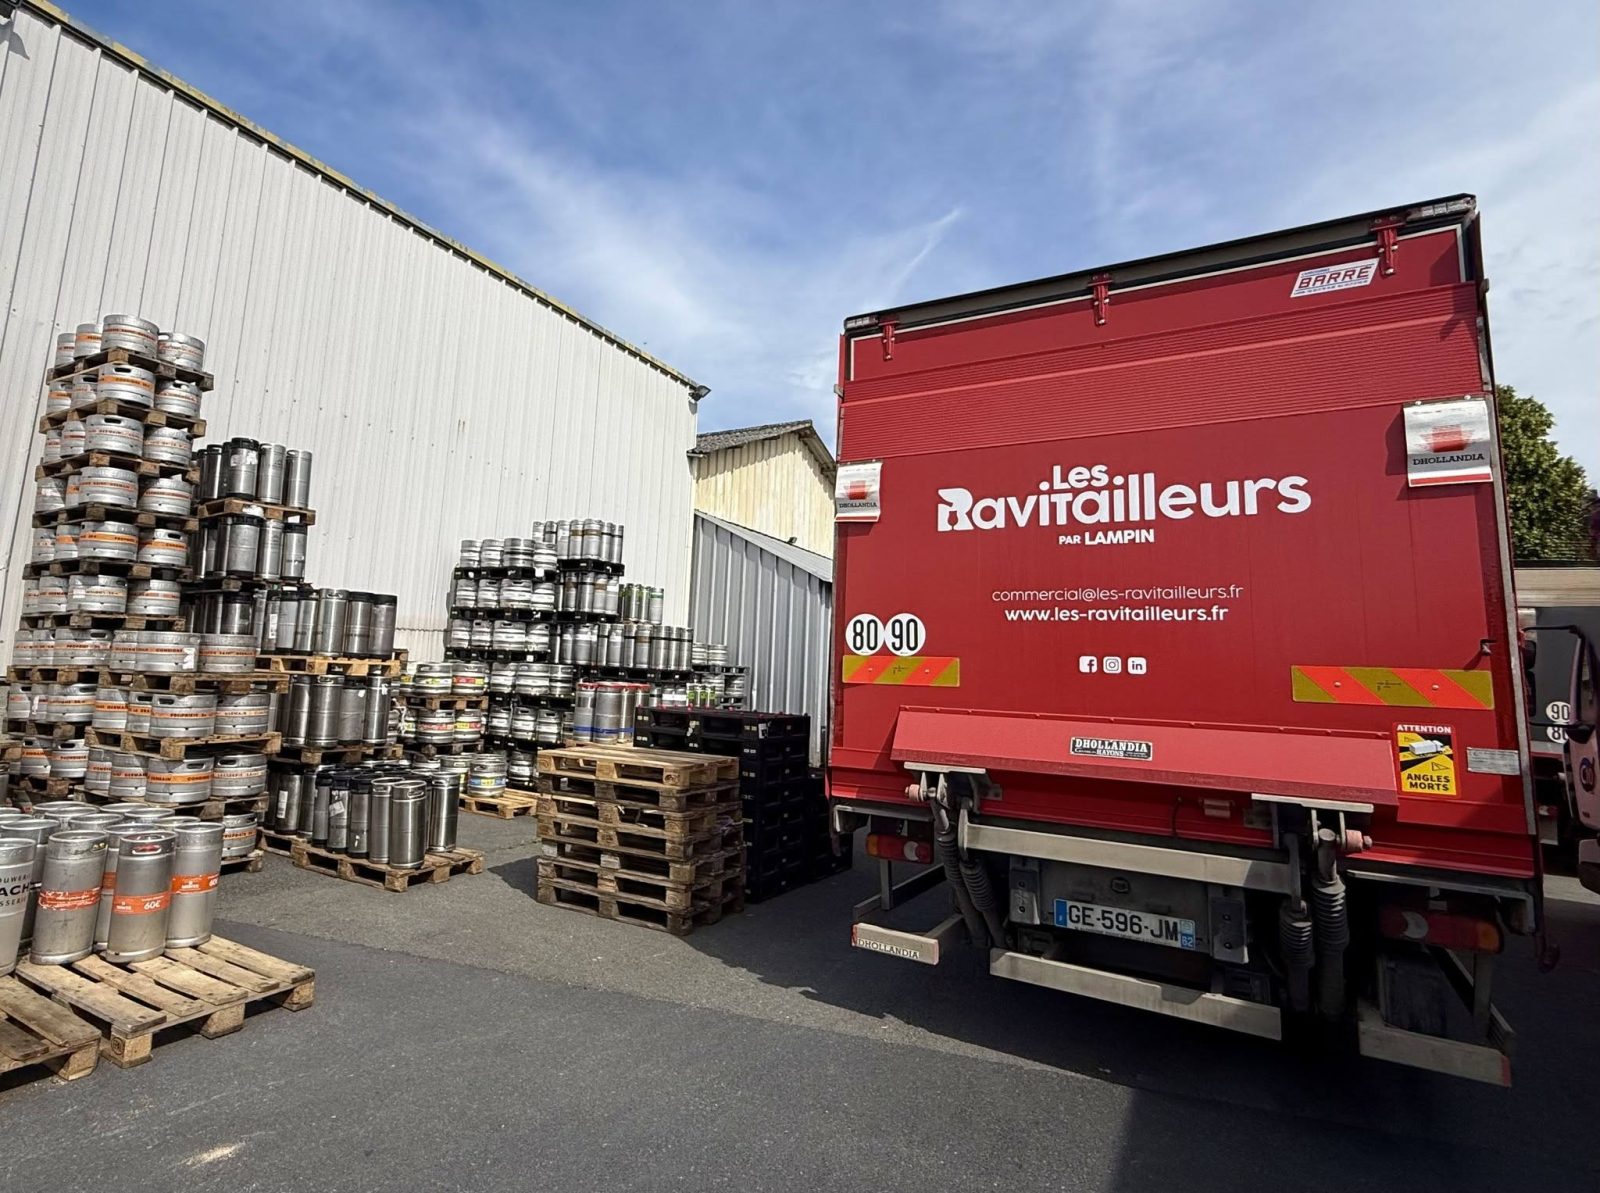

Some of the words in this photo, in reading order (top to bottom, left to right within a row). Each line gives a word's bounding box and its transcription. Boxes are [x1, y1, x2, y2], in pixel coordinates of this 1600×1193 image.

[1413, 453, 1485, 465] DHOLLANDIA
[1053, 464, 1109, 490] Les
[937, 472, 1312, 532] Ravitailleurs
[1058, 535, 1081, 545] PAR
[1084, 529, 1155, 545] LAMPIN
[992, 584, 1244, 602] commercial@les-ravitailleurs.fr
[1004, 605, 1229, 621] www.les-ravitailleurs.fr
[853, 619, 878, 651] 80
[891, 618, 918, 651] 90
[1551, 704, 1570, 720] 90
[1396, 724, 1452, 734] ATTENTION
[1075, 738, 1148, 752] DHOLLANDIA
[1406, 773, 1451, 783] ANGLES
[1409, 781, 1449, 791] MORTS
[1068, 904, 1179, 942] GE-596-JM
[858, 939, 919, 960] DHOLLANDIA
